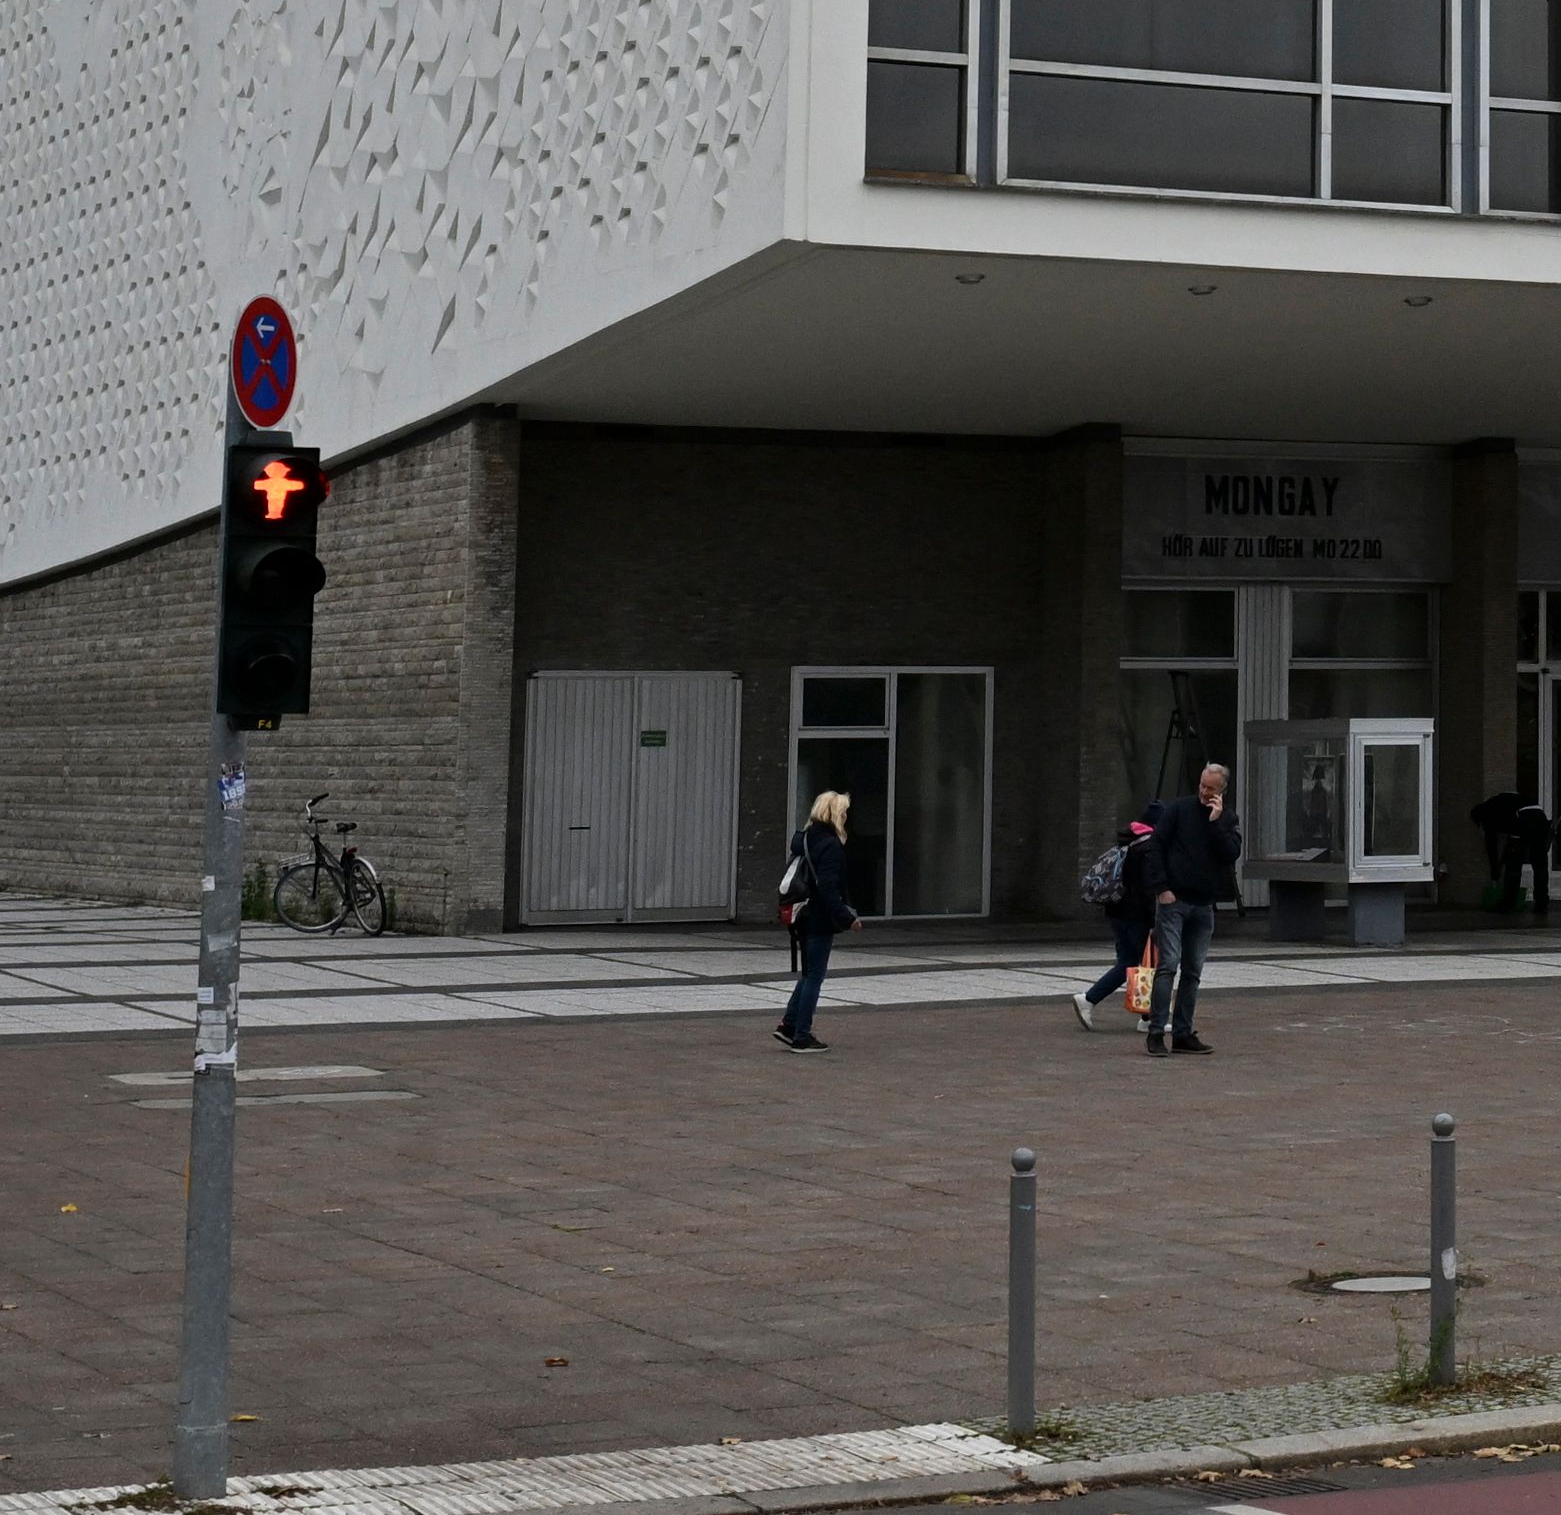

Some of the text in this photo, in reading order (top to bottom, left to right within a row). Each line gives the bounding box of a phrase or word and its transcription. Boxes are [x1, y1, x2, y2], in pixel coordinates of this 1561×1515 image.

[1204, 474, 1340, 517] MONGAY
[1162, 533, 1193, 557] HÖR
[1198, 536, 1229, 558] AUF
[1234, 537, 1254, 558] ZU
[1258, 534, 1304, 559] LÜGEN
[257, 719, 273, 730] F4
